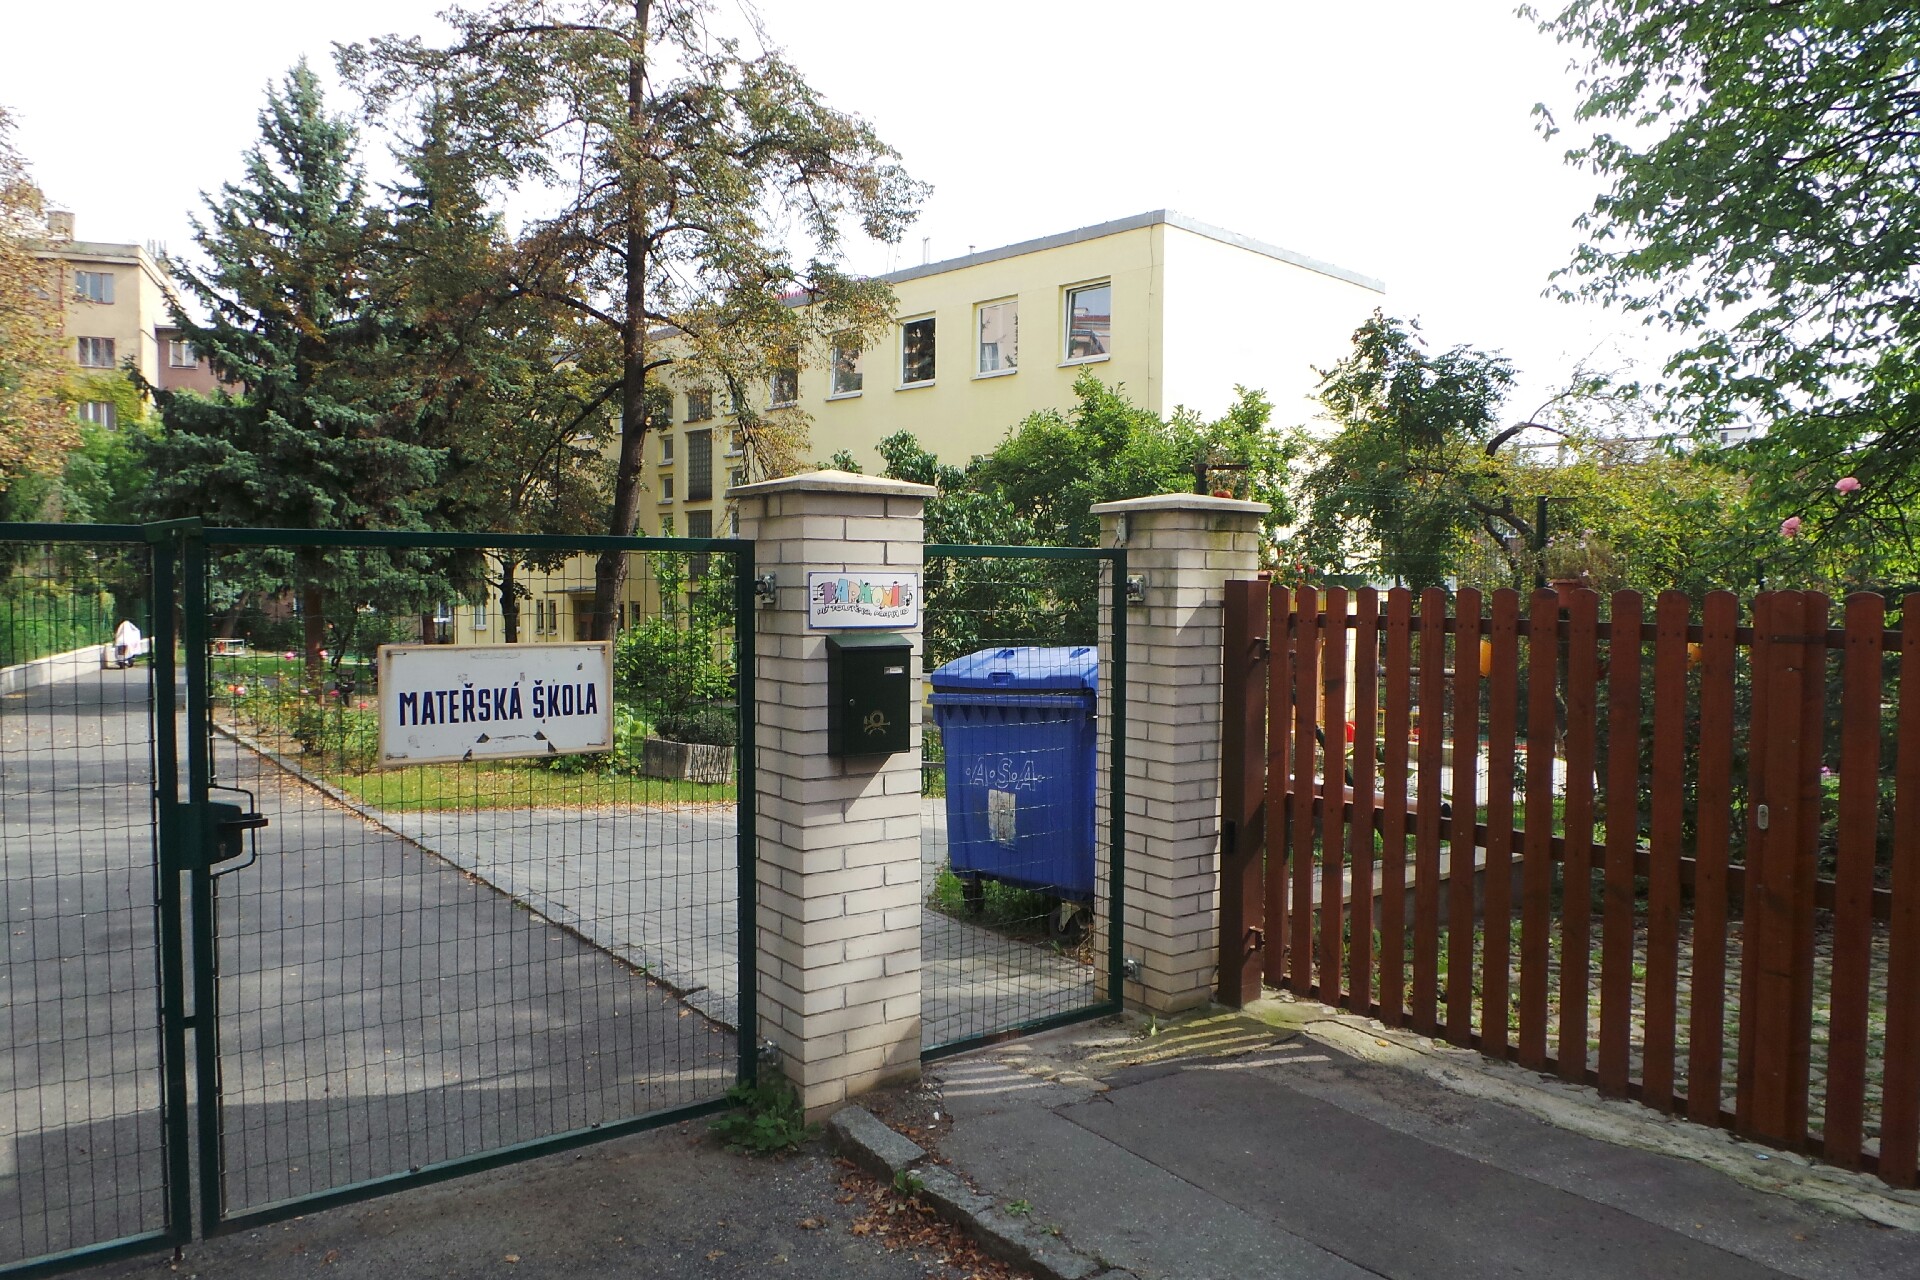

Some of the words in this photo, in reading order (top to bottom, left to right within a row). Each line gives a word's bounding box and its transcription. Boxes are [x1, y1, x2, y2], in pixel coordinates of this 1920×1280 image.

[823, 578, 908, 607] HARMONIE
[399, 681, 523, 726] MATEŘSKÁ
[532, 680, 598, 718] ŠKOLA
